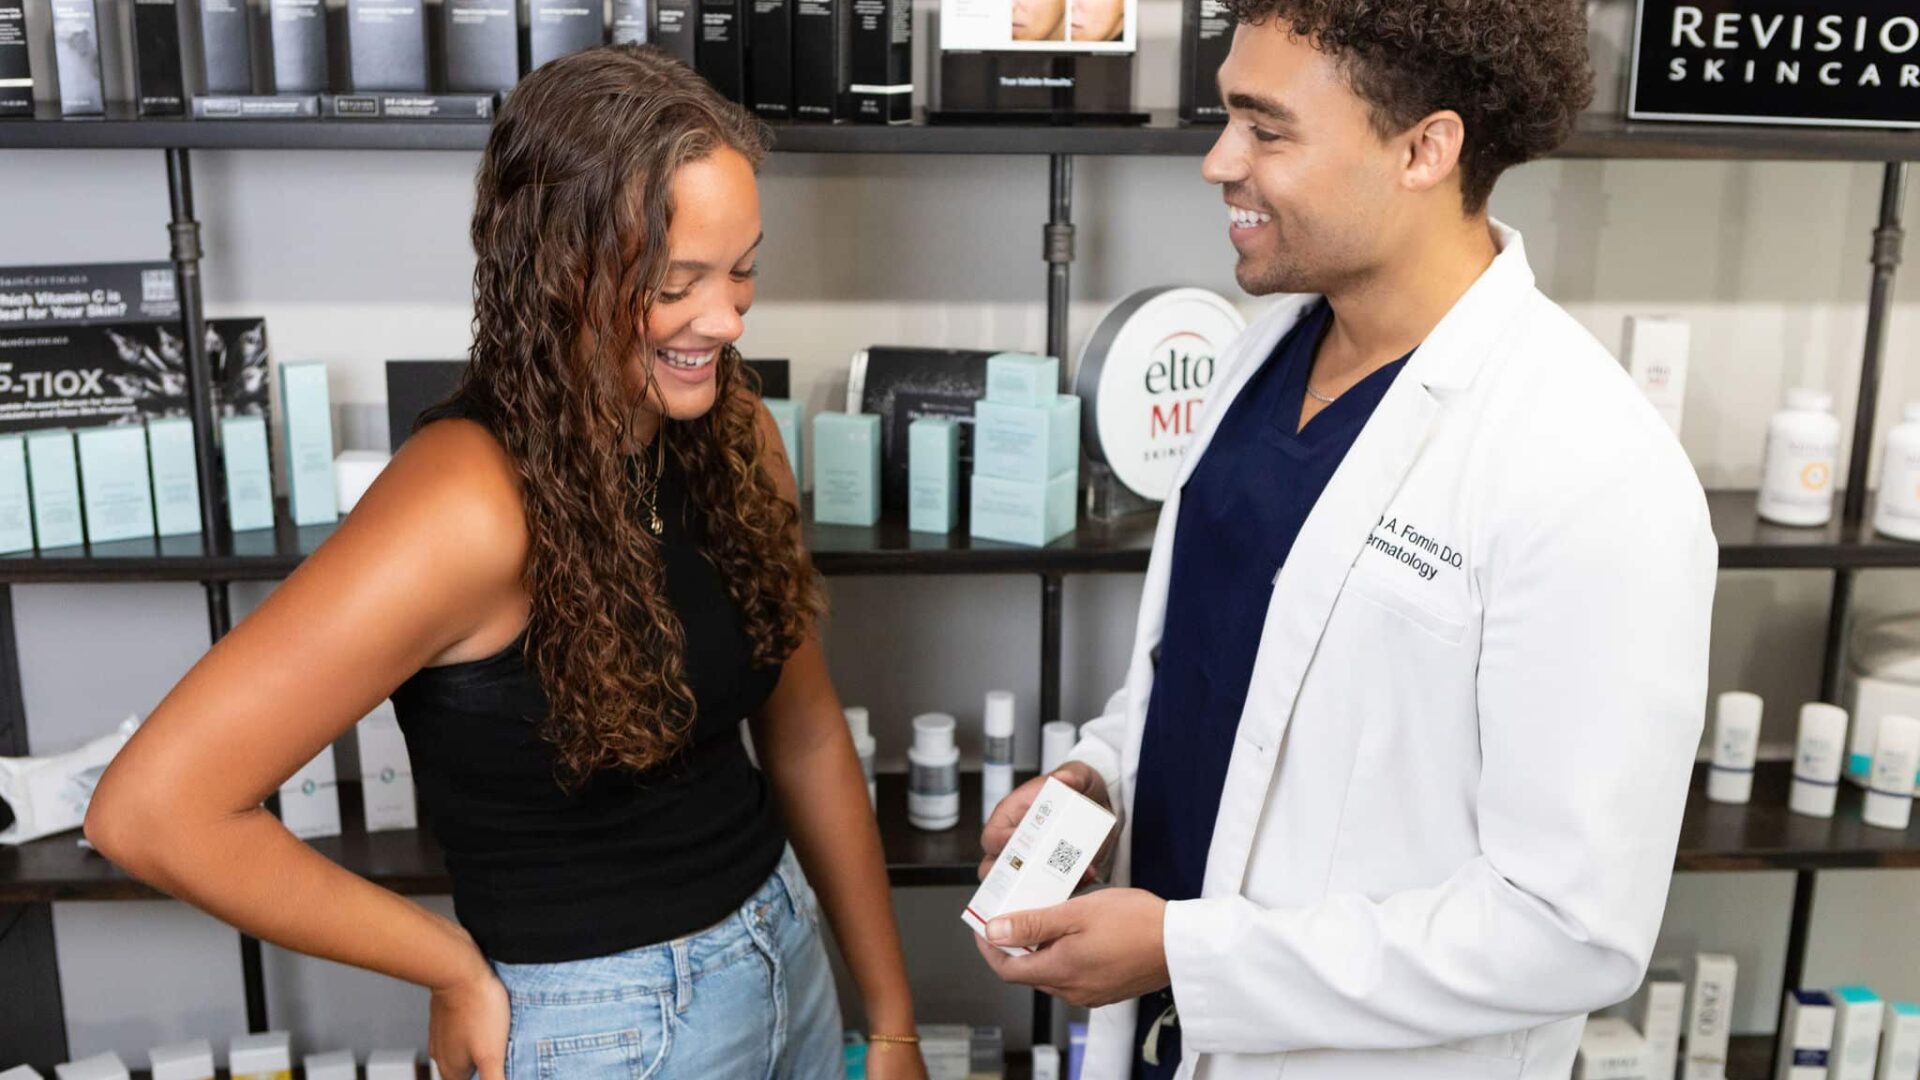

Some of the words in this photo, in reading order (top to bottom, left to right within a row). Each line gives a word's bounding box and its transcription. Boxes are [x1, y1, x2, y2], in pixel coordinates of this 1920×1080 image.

[1670, 5, 1920, 53] REVISIO
[1668, 57, 1920, 87] SKINCAR
[50, 305, 85, 319] Your
[91, 288, 105, 304] C
[1384, 517, 1397, 535] A.
[1401, 524, 1438, 555] Fomin
[1366, 533, 1438, 580] ermatology
